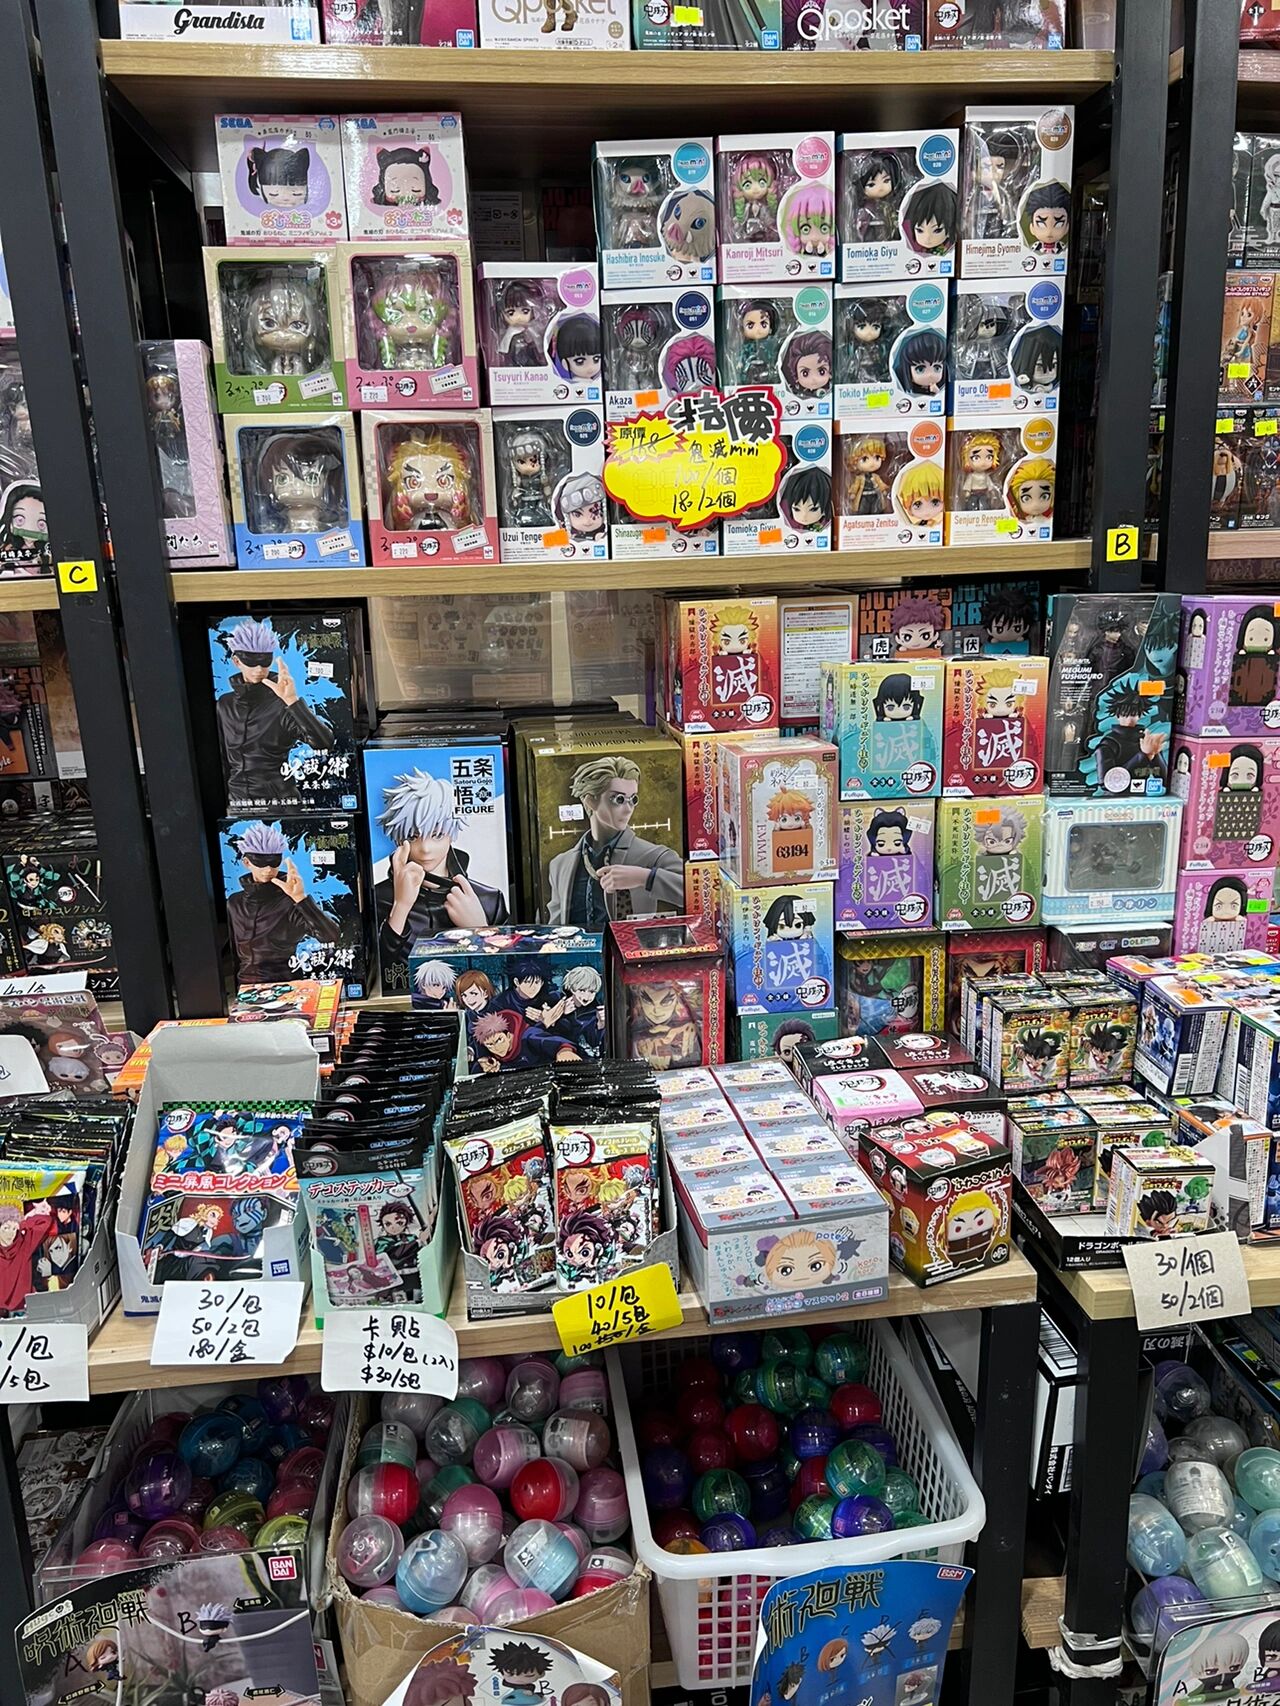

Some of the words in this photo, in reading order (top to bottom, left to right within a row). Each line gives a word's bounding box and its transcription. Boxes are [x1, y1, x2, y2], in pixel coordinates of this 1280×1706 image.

[173, 9, 264, 35] Grandista
[797, 0, 912, 41] Qposket
[219, 117, 253, 135] SEGA
[606, 253, 638, 265] Hashibira
[639, 253, 666, 263] Inosuke
[726, 248, 754, 263] Kanroji
[755, 247, 784, 259] Mitsuri
[847, 247, 879, 258] Tomioka
[880, 247, 898, 260] Giyu
[965, 244, 997, 258] Himejima
[493, 371, 522, 384] Tsuyuri
[524, 371, 549, 382] Kanao
[609, 394, 633, 406] Akaza
[838, 387, 862, 399] Tokito
[958, 385, 978, 398] Iguro
[667, 390, 776, 443] 特價
[619, 426, 646, 439] 原價
[727, 524, 759, 535] Tomioka
[843, 519, 875, 532] Agatsuma
[875, 517, 899, 529] Zenitsu
[954, 514, 980, 528] Senjuro
[502, 531, 518, 543] Uzui
[520, 531, 543, 547] Tenge
[1115, 533, 1131, 556] B
[70, 566, 88, 584] C
[965, 639, 978, 654] 伏
[1061, 666, 1093, 674] MEGUMI
[1061, 672, 1104, 681] FUSHIGURO
[713, 655, 758, 704] 滅
[874, 722, 920, 769] 滅
[976, 718, 1022, 769] 滅
[453, 757, 494, 779] 五条
[453, 777, 477, 786] Satoru
[476, 777, 493, 788] Gojo
[454, 786, 475, 806] 悟
[454, 804, 495, 815] FIGURE
[755, 823, 768, 863] EMMA
[776, 843, 809, 859] 63194
[867, 855, 912, 903] 滅
[976, 857, 1022, 903] 滅
[768, 941, 812, 988] 滅
[555, 1139, 588, 1157] 鬼滅の刃
[307, 1177, 398, 1198] デコステッカー
[197, 1285, 264, 1316] 30/包
[587, 1284, 641, 1320] 10/包
[1160, 1280, 1225, 1317] 50/2個
[191, 1316, 261, 1343] 50/2包
[362, 1314, 380, 1341] 卡
[590, 1308, 651, 1336] 40/5包
[0, 1327, 54, 1361] /包
[187, 1337, 256, 1364] 180/盒
[363, 1342, 419, 1364] $10/包
[360, 1365, 421, 1390] $30/5包
[271, 1560, 293, 1569] BAN
[272, 1568, 292, 1578] DAI
[180, 1612, 197, 1635] B
[64, 1655, 88, 1677] A
[1253, 1667, 1267, 1683] B
[539, 1679, 555, 1696] B
[1172, 1679, 1189, 1697] A
